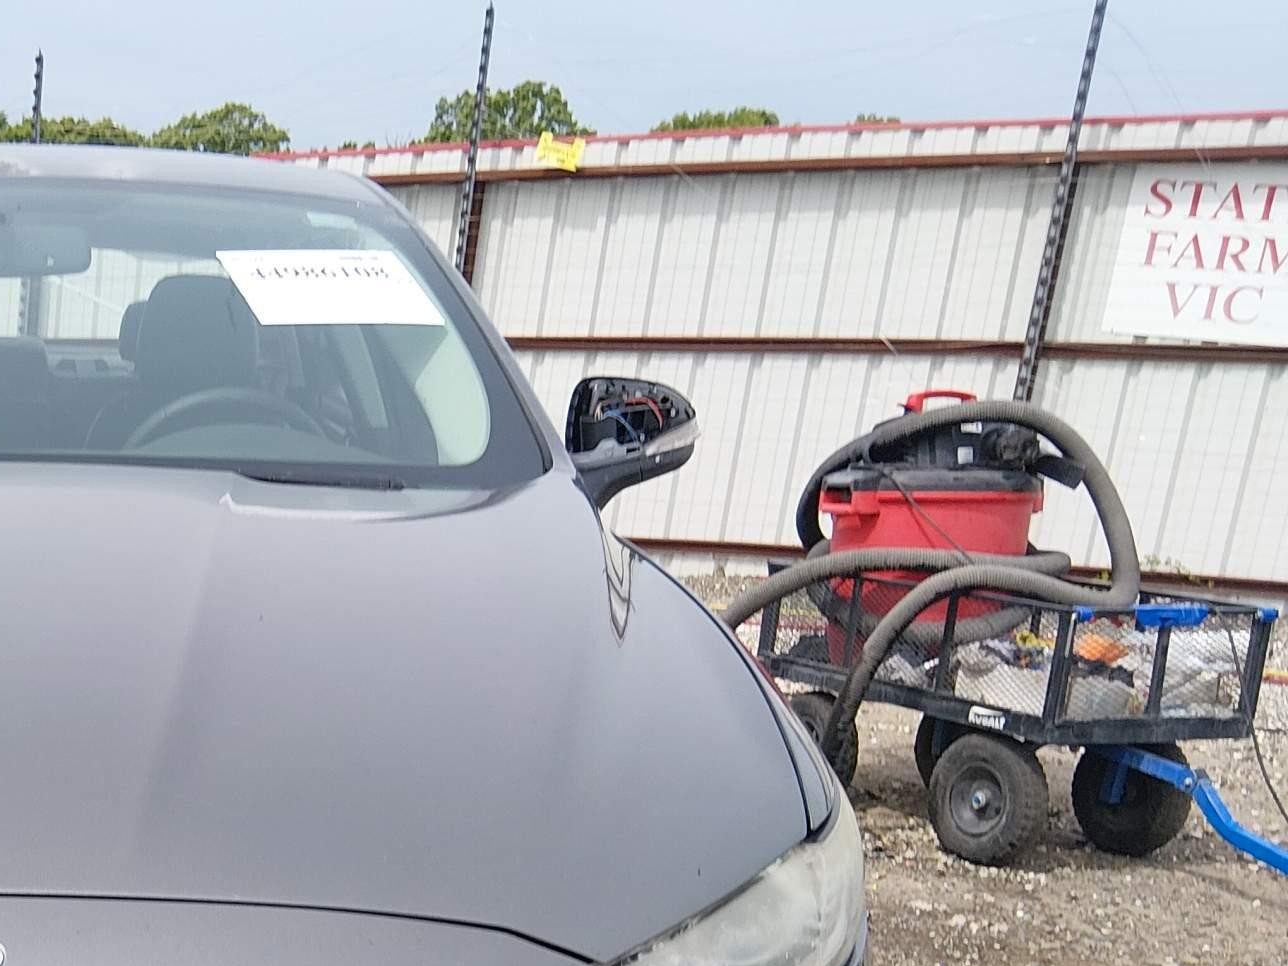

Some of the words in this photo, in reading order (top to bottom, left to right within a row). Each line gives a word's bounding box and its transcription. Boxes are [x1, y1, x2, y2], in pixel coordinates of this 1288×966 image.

[1143, 178, 1288, 222] STAT
[1141, 230, 1288, 275] FARM
[1165, 281, 1264, 324] VIC
